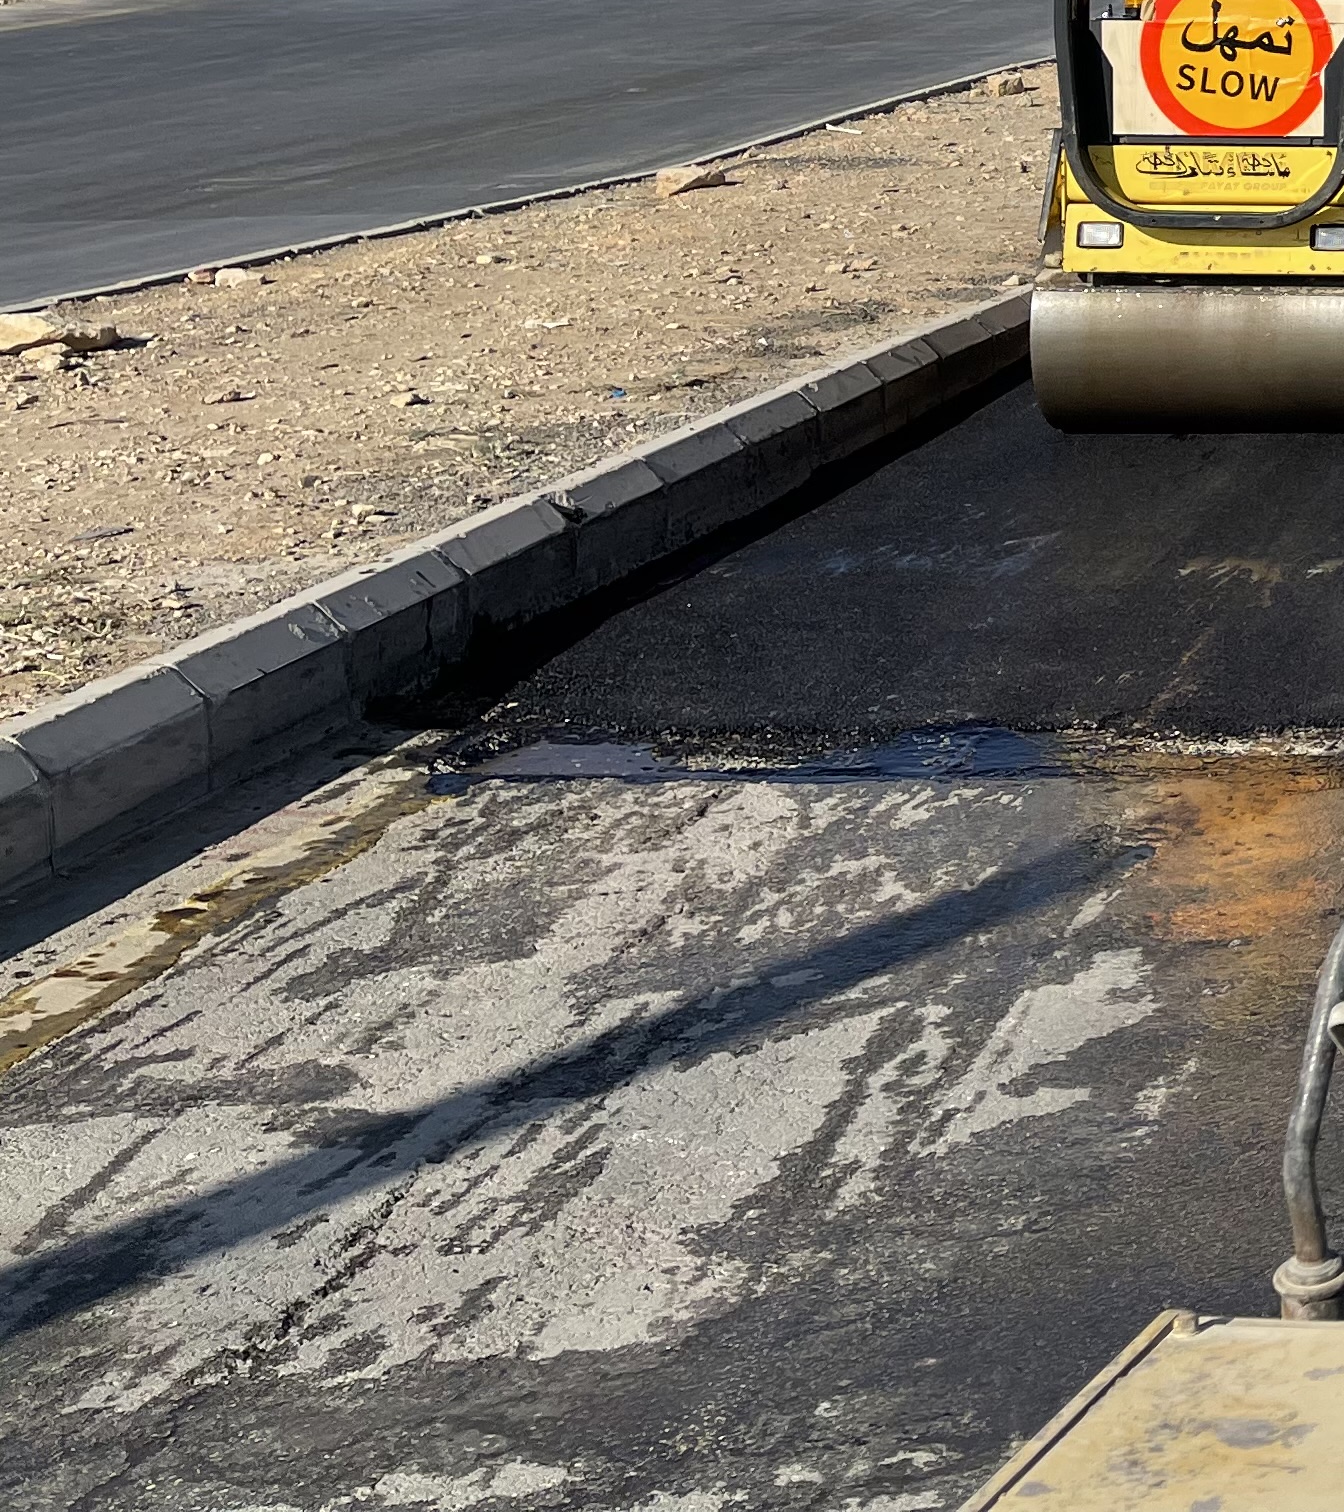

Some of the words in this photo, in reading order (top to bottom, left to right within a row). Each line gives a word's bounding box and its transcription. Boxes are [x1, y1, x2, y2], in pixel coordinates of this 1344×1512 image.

[1176, 64, 1280, 102] SLOW
[1200, 182, 1239, 192] FAYAT
[1243, 182, 1288, 192] GROUP
